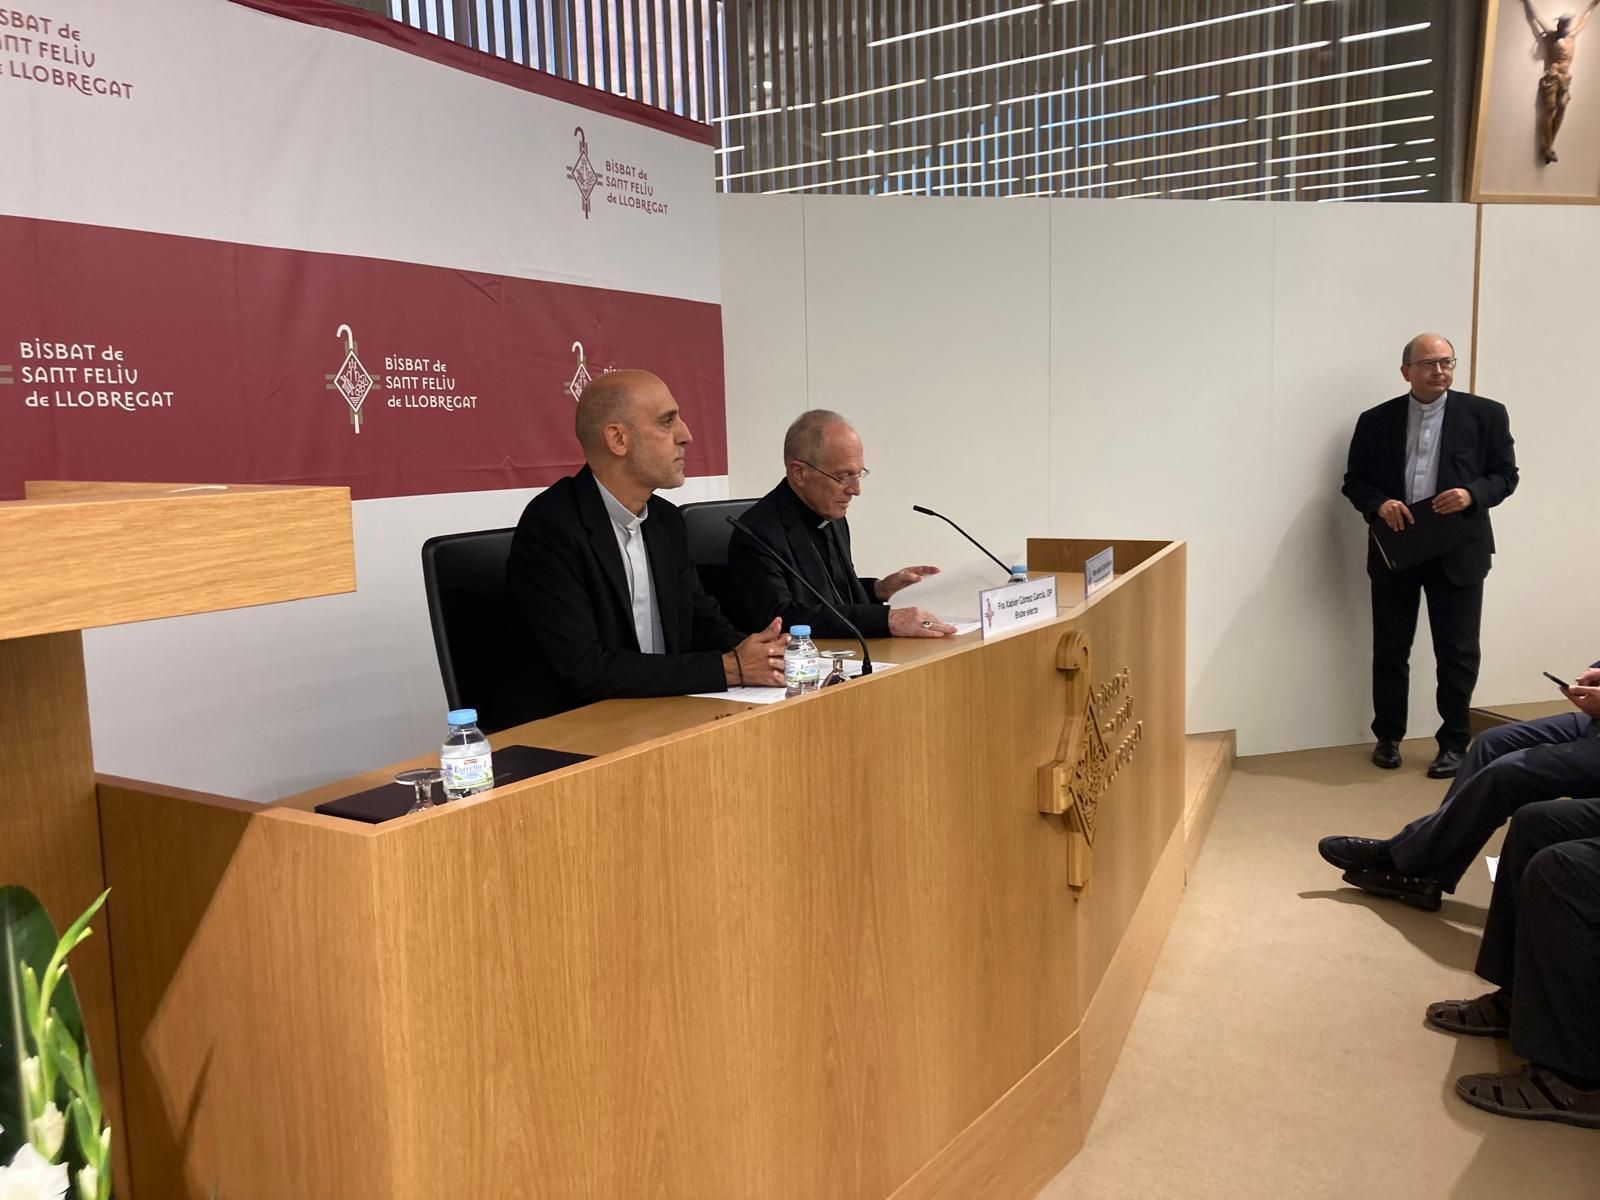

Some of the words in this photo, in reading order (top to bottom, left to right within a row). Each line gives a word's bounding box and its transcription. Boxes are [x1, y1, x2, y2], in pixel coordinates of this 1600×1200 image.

[58, 24, 81, 41] de
[10, 60, 133, 99] LLOBREGAT
[638, 169, 648, 181] de
[607, 192, 617, 204] de
[618, 194, 668, 215] LLOBREGAT
[101, 345, 124, 361] de
[22, 366, 77, 384] SANT
[432, 360, 447, 373] de
[385, 375, 419, 390] SANT
[25, 391, 50, 407] de
[55, 390, 174, 411] LLOBREGAT
[387, 395, 402, 408] de
[405, 395, 478, 412] LLOBREGAT
